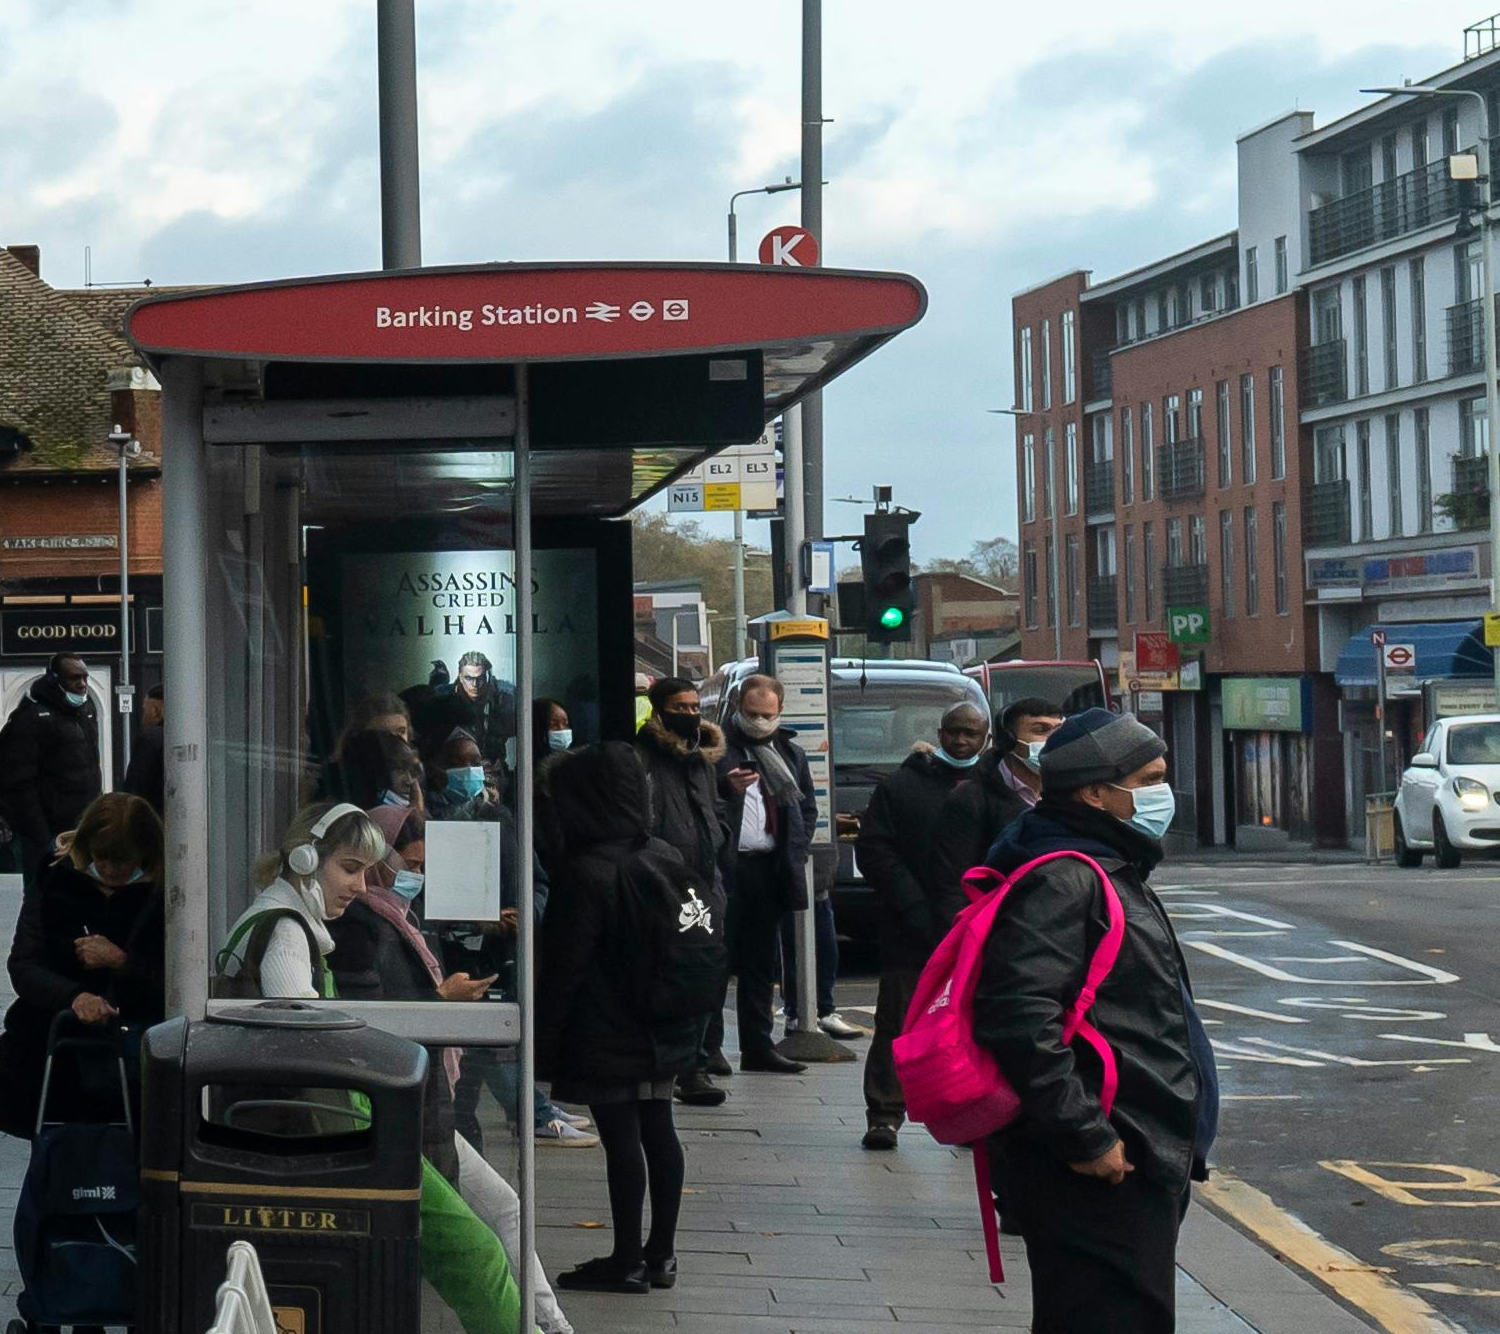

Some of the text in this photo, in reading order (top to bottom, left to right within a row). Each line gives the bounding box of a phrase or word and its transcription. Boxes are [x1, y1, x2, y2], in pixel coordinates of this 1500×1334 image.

[772, 234, 805, 267] K
[376, 303, 578, 330] Barking Station
[710, 464, 732, 475] EL2
[746, 463, 769, 474] EL3
[673, 493, 699, 504] N15
[432, 593, 505, 608] CREED
[17, 624, 116, 639] GOOD FOOD
[1373, 632, 1385, 645] N
[72, 1185, 101, 1199] gimi
[223, 1207, 338, 1230] LITTER
